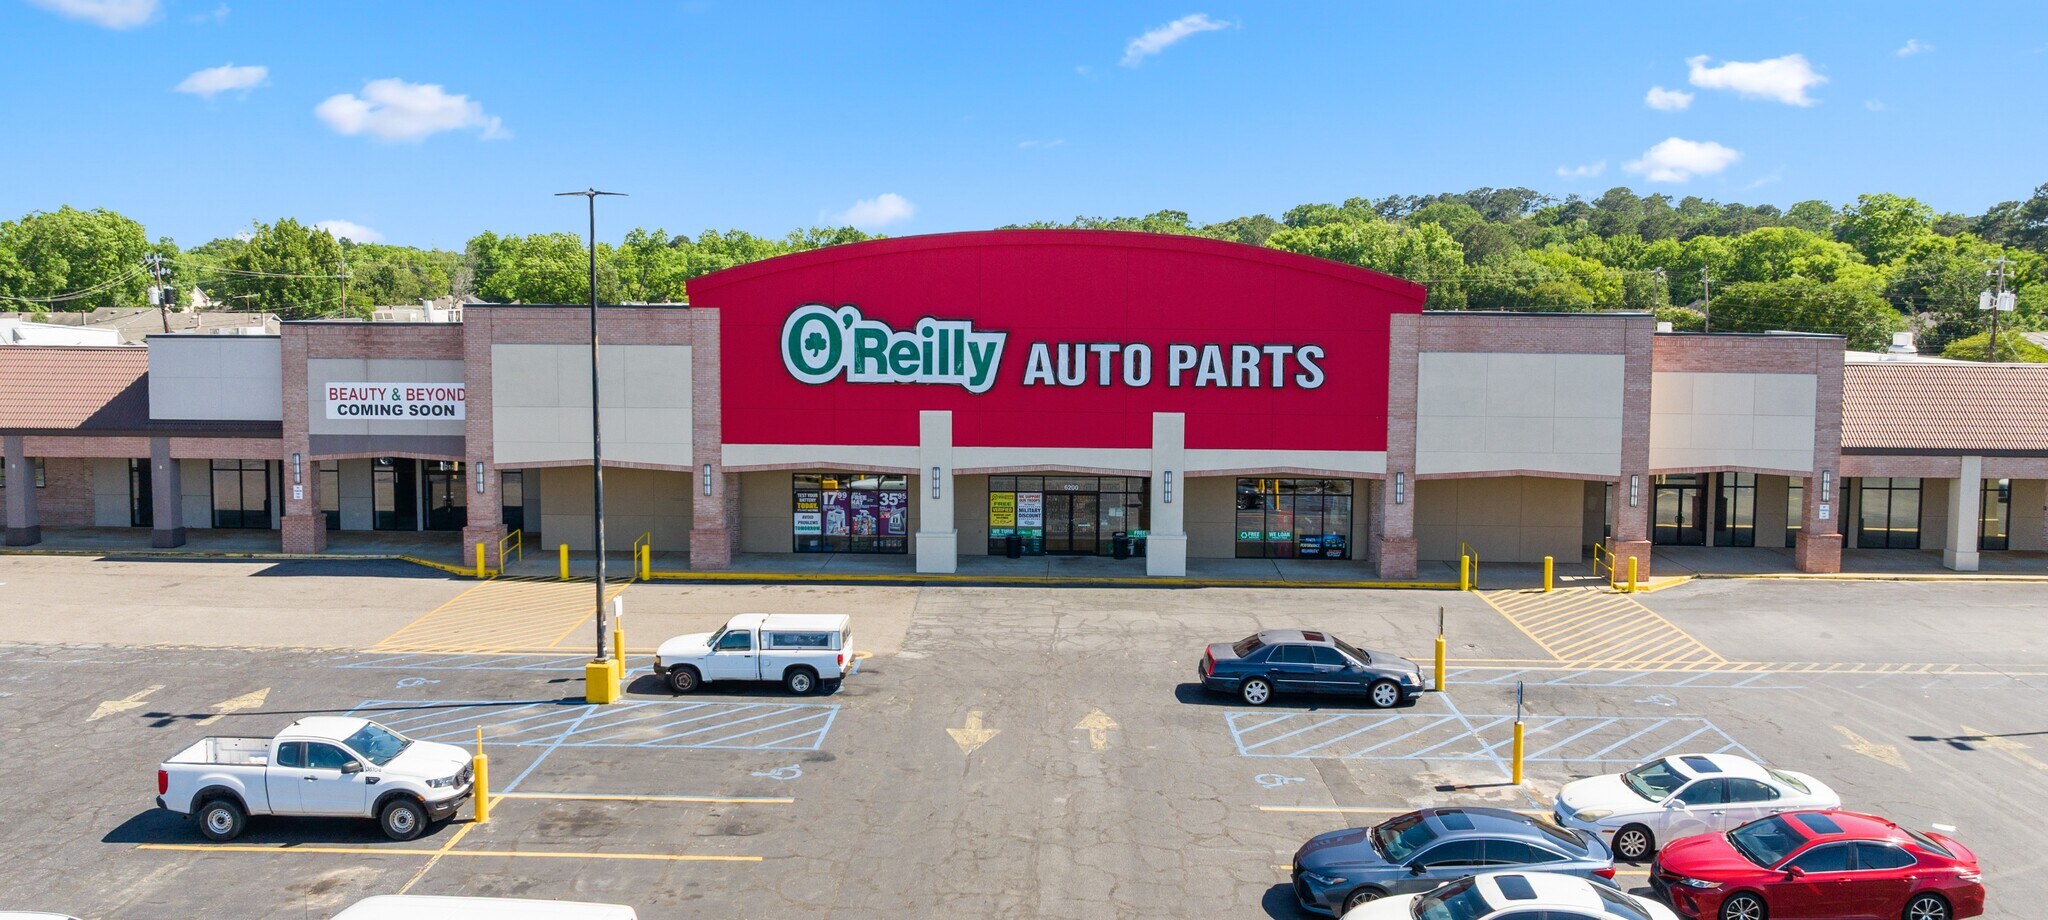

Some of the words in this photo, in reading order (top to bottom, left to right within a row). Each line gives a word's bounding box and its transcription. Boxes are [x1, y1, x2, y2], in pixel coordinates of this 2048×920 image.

[786, 310, 999, 387] O'Reilly
[1023, 342, 1152, 388] AUTO
[1168, 343, 1326, 390] PARTS
[329, 387, 387, 401] BEAUTY
[391, 387, 401, 401] &
[406, 387, 466, 401] BEYOND
[337, 404, 403, 416] COMING
[409, 404, 455, 416] SOON
